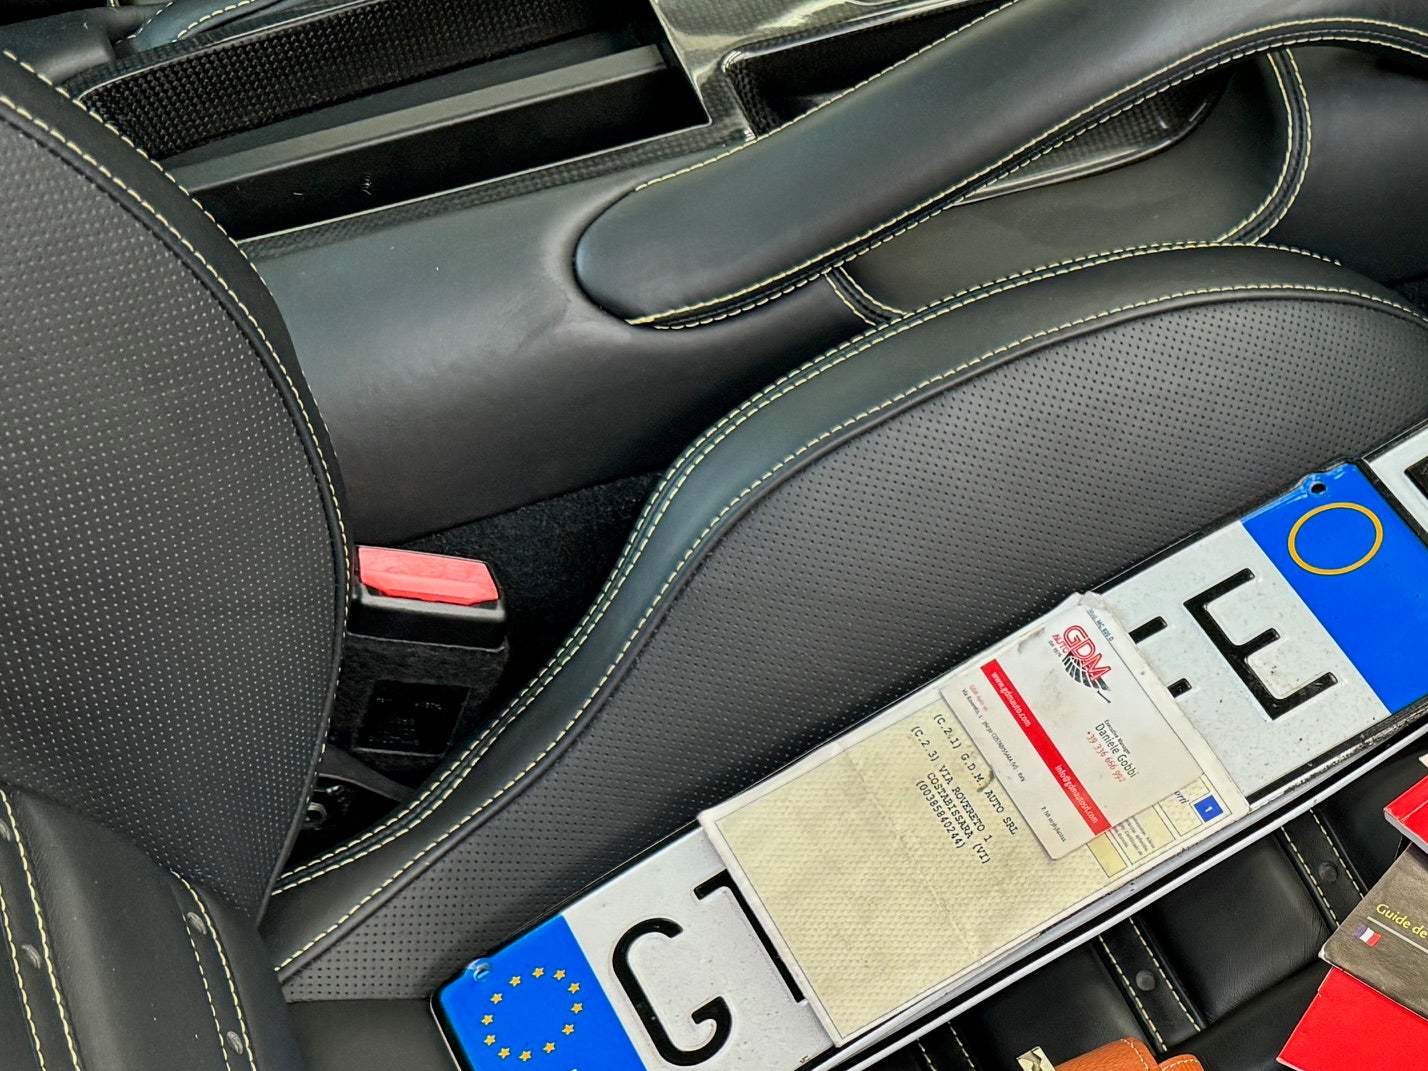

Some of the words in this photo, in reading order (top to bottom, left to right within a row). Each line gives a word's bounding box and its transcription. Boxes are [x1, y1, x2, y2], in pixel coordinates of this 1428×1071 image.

[1063, 625, 1112, 681] GDM
[991, 671, 1032, 728] www.gdmauto.com
[933, 714, 962, 750] (C.2.1)
[960, 753, 985, 787] G.D.M.
[984, 790, 1005, 814] AUTO
[1002, 816, 1019, 836] SRL
[1095, 723, 1120, 755] Daniele
[1117, 754, 1140, 778] Gobbi
[911, 726, 940, 762] (C.2.3)
[938, 765, 954, 786] VIA
[952, 786, 986, 832] ROVERETO
[983, 834, 993, 843] 1
[915, 780, 966, 849] (00385840244)
[1054, 764, 1099, 824] info@gdmautosrl.com
[927, 772, 974, 839] COSTABISSARA
[972, 843, 991, 865] (VI)
[1376, 902, 1411, 930] Guide
[1411, 925, 1428, 939] de
